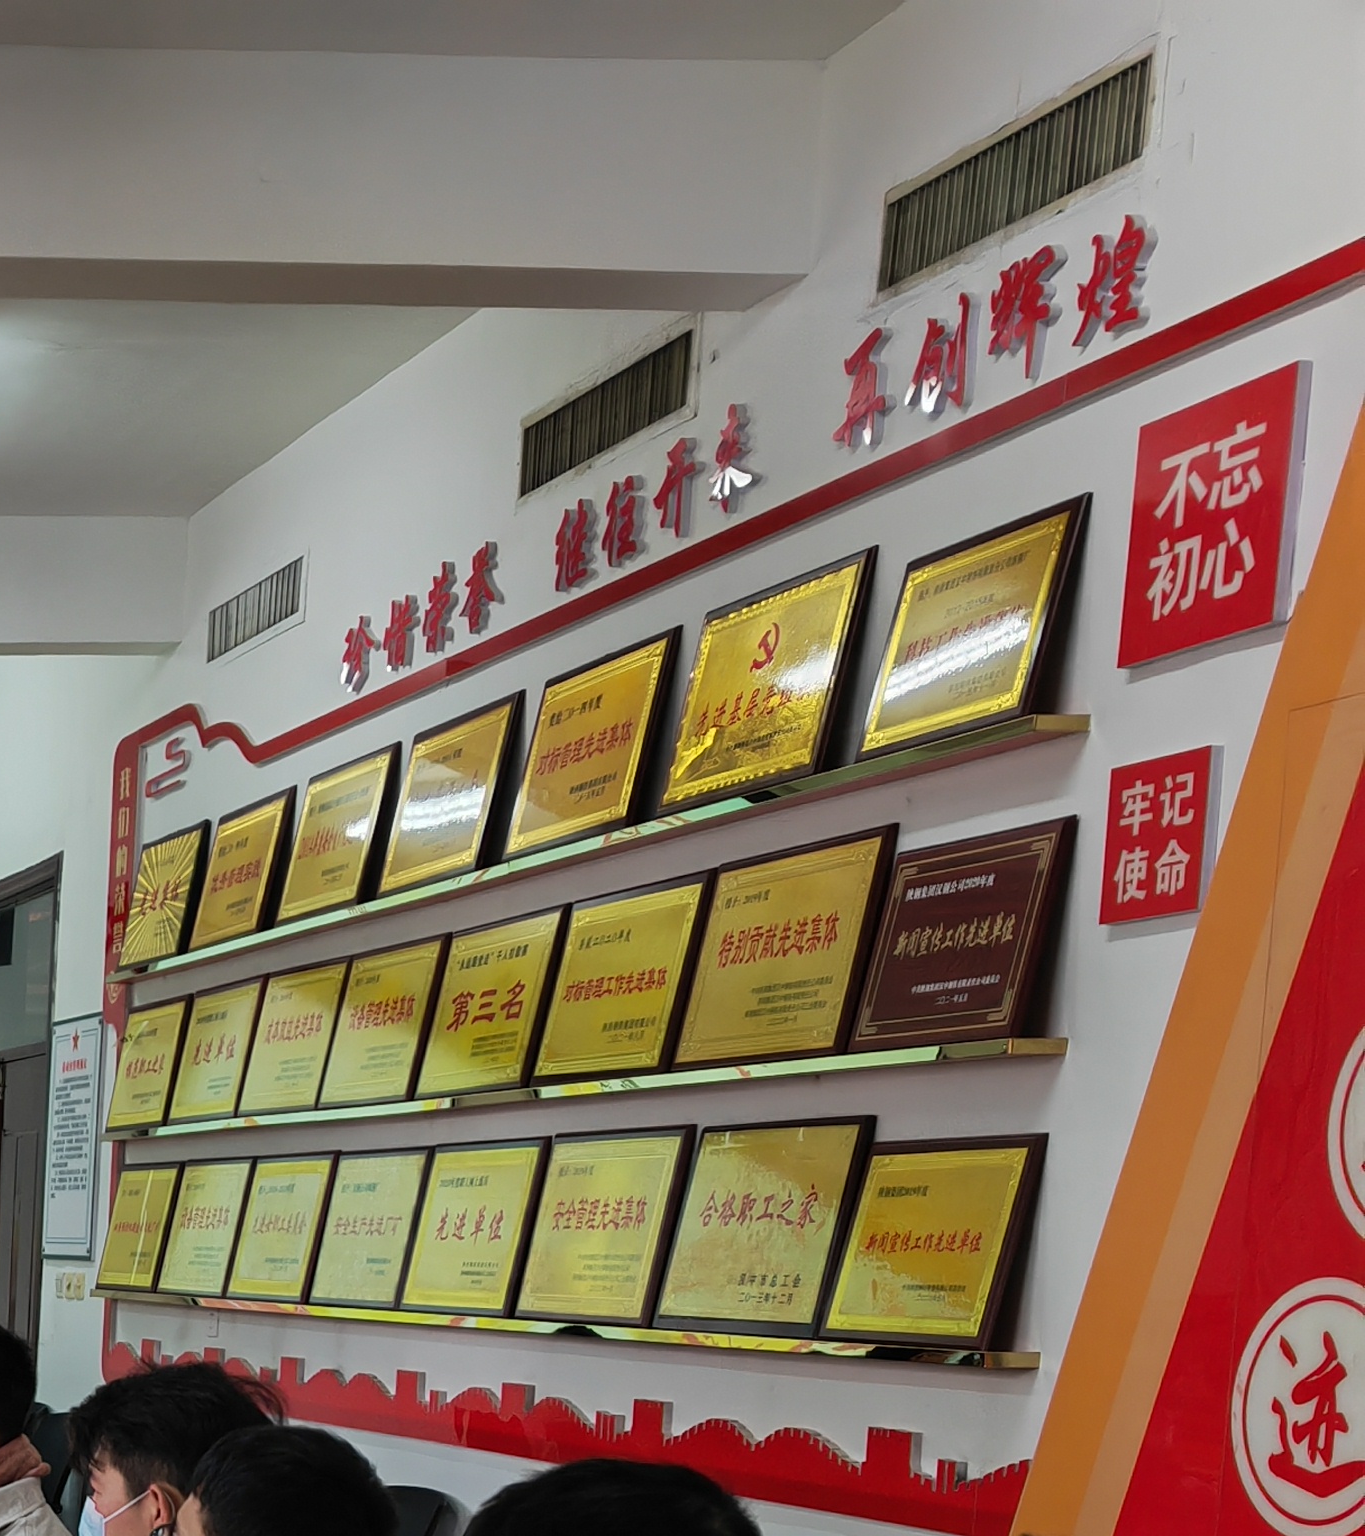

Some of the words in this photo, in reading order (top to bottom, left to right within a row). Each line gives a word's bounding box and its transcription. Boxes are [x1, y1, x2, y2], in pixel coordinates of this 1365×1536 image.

[832, 213, 1153, 449] 再创辉煌
[555, 403, 757, 593] 继往开来
[1153, 420, 1268, 530] 不忘
[1146, 519, 1257, 623] 初心
[340, 541, 500, 693] 珍惜荣誉
[1118, 771, 1195, 837] 牢记
[1113, 840, 1192, 903] 使命
[717, 909, 841, 970] 特别贡献先进集体
[893, 910, 1017, 961] 新闻宣传工作先进单位
[445, 978, 527, 1033] 第三名
[434, 1204, 505, 1247] 先进单位
[552, 1195, 648, 1232] 安全管理先进集体
[699, 1182, 818, 1229] 合格职工之家
[864, 1228, 984, 1255] 新闻宣传工作先进单位
[1267, 1329, 1365, 1499] 迹
